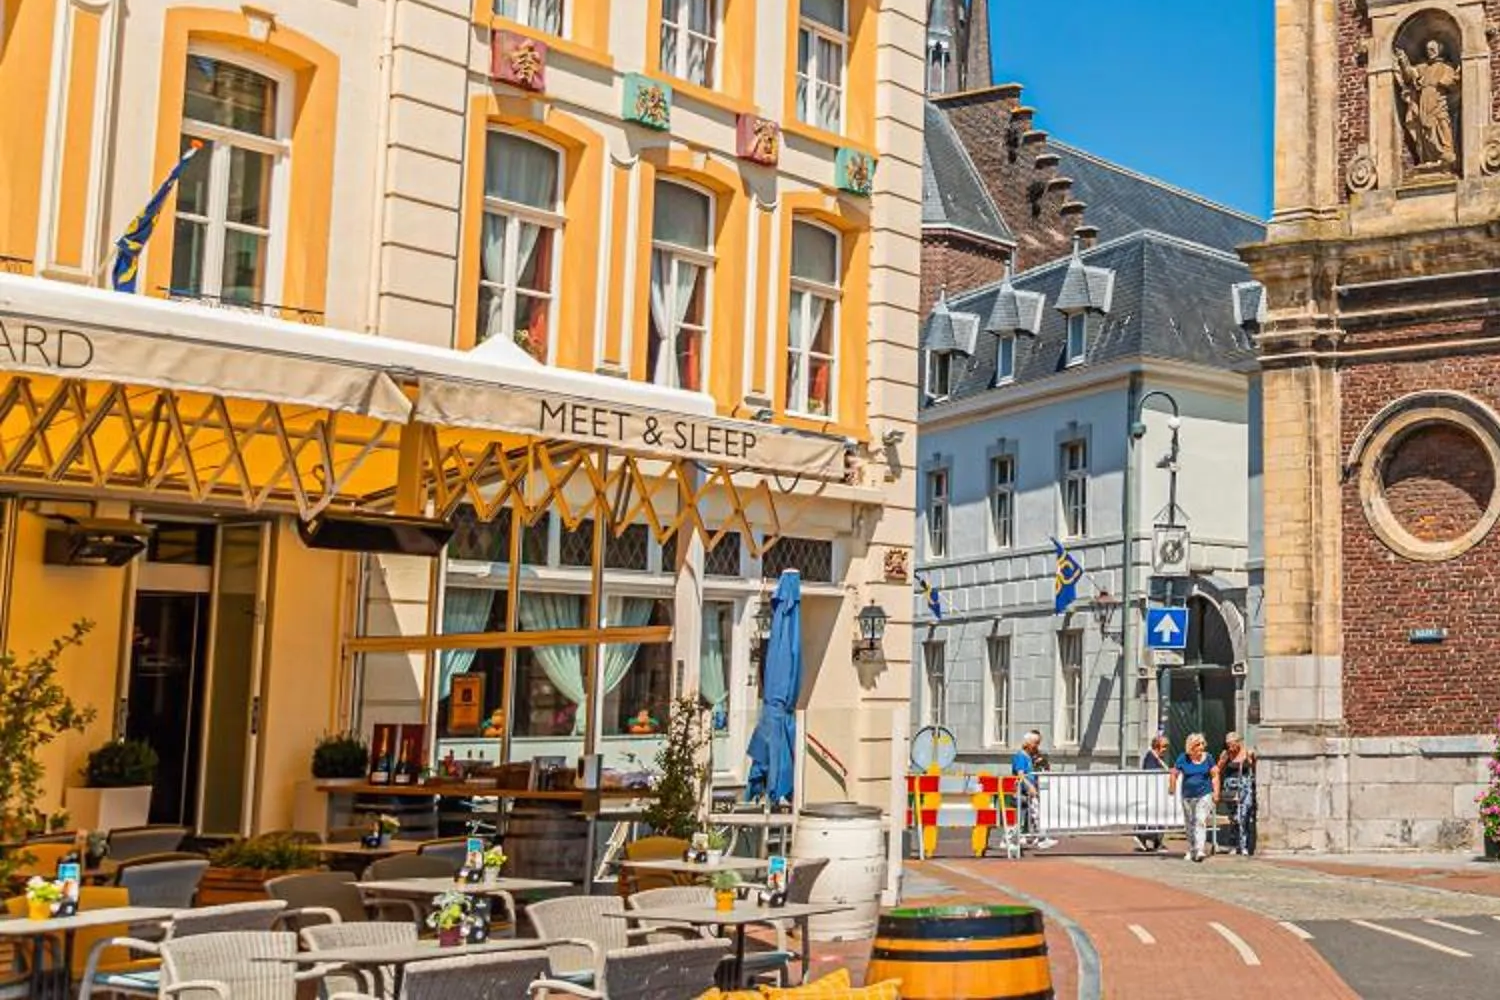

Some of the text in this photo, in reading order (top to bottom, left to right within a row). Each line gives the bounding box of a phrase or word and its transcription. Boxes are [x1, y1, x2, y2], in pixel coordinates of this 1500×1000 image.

[540, 400, 757, 459] MEET & SLEEP
